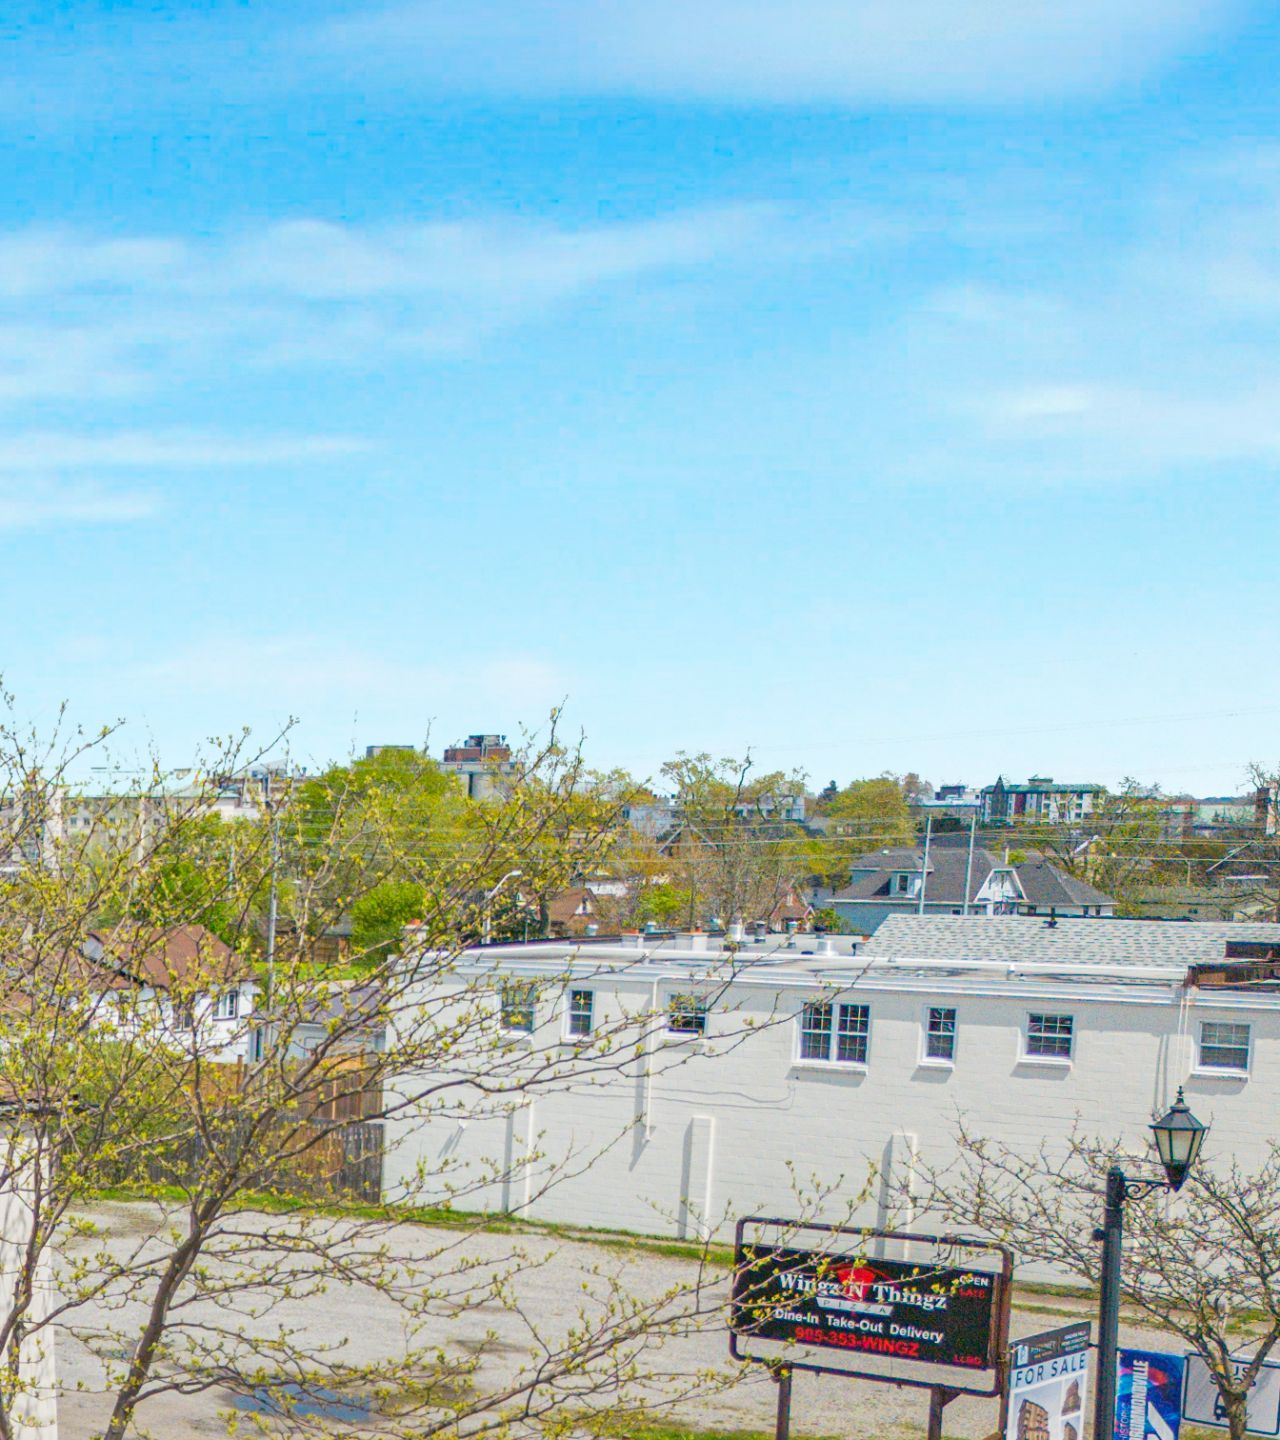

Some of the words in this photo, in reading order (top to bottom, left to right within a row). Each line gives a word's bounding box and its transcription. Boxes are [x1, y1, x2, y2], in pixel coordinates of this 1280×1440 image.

[780, 1273, 842, 1297] Wingz
[873, 1284, 947, 1311] Thingz
[823, 1300, 886, 1314] PIZZA
[774, 1308, 819, 1325] Dine-In
[825, 1314, 883, 1333] Take-Out
[890, 1324, 944, 1344] Delivery
[795, 1326, 921, 1357] 905-353-WINGZ
[1015, 1365, 1044, 1388] FOR
[1051, 1353, 1086, 1378] SALE
